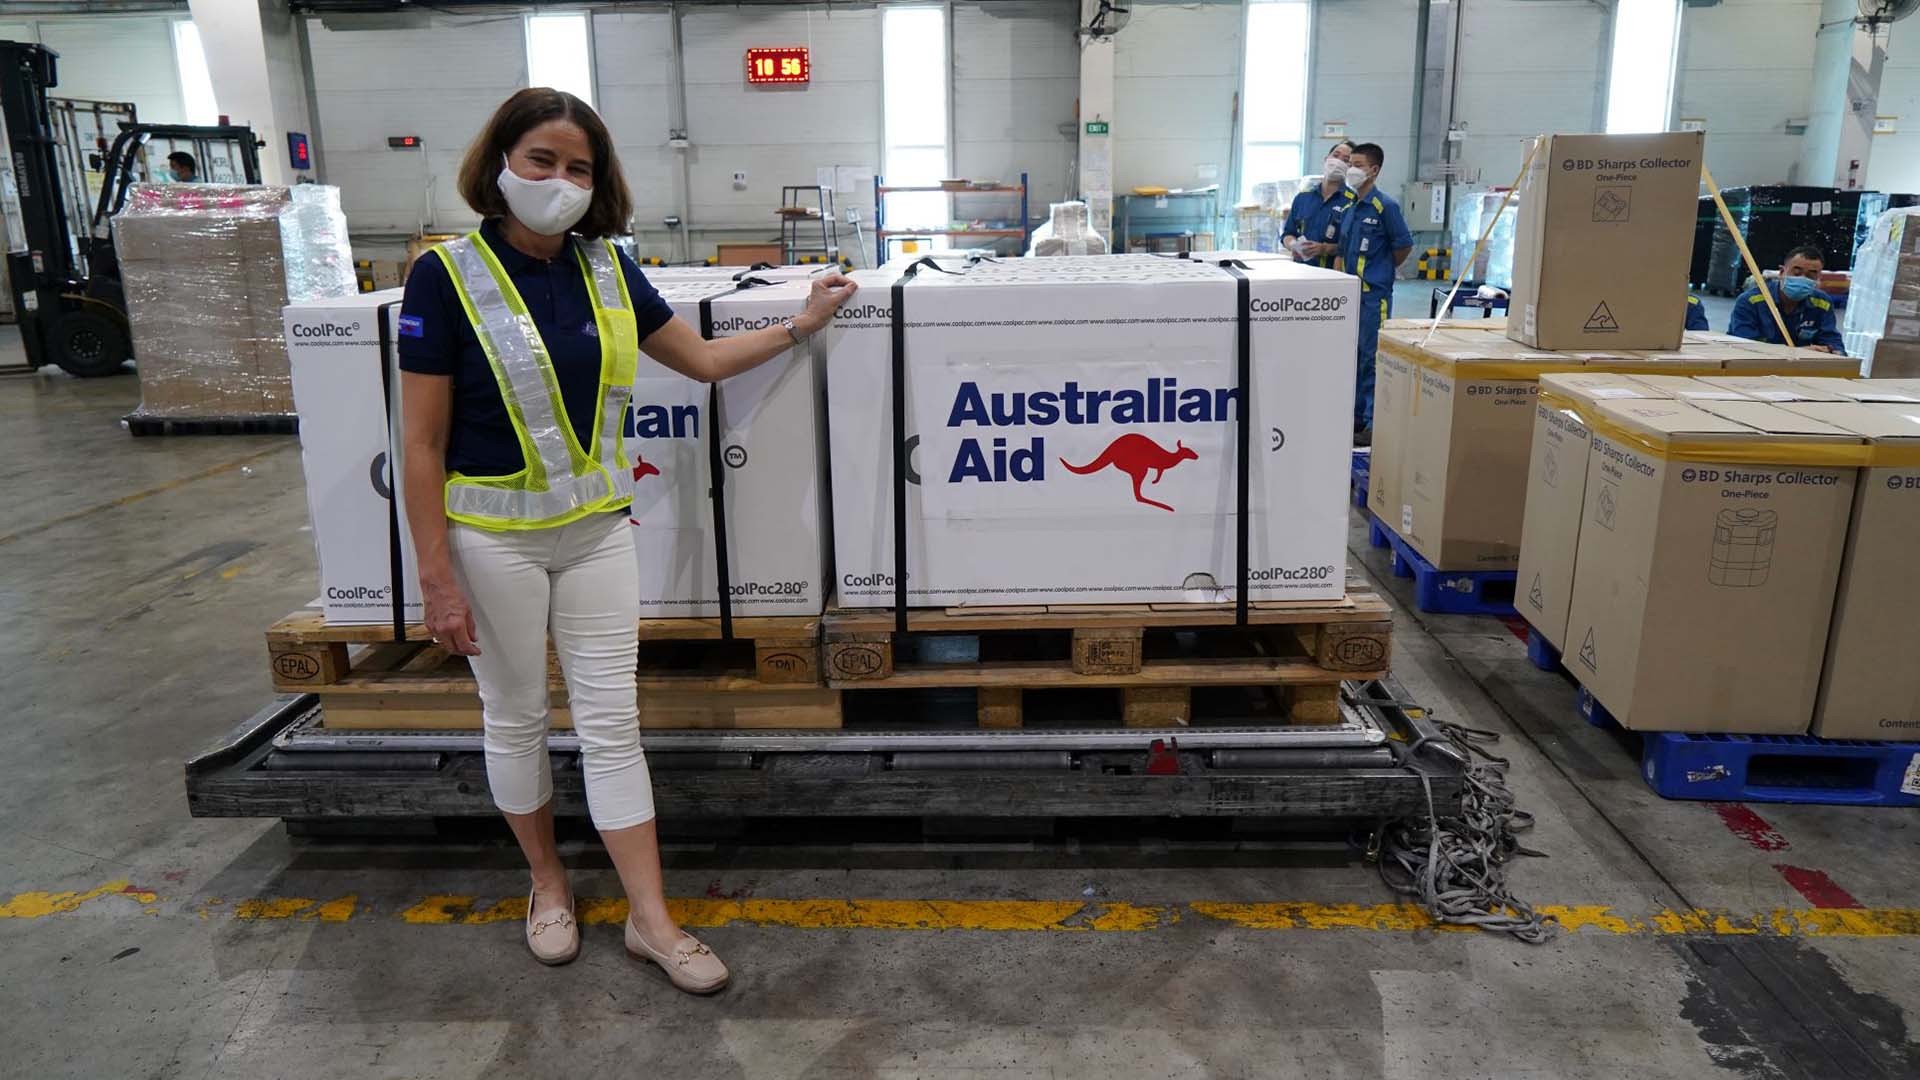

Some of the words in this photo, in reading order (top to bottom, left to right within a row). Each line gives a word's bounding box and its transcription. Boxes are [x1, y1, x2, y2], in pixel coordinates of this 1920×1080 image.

[755, 58, 774, 76] 10
[781, 58, 801, 76] 56
[1576, 159, 1594, 170] BD
[1598, 158, 1637, 171] Sharps
[1640, 158, 1691, 169] Collector
[1596, 174, 1637, 182] One-Piece
[1250, 297, 1341, 312] CoolPac280
[292, 323, 353, 337] CoolPac
[1478, 386, 1492, 395] BD
[1495, 386, 1527, 397] Sharps
[948, 437, 1044, 482] Aid
[1594, 437, 1603, 451] BD
[1603, 443, 1624, 463] Sharps
[1625, 454, 1655, 478] Collector
[1699, 470, 1719, 482] BD
[1724, 471, 1772, 485] Sharps
[1776, 472, 1839, 486] Collector
[1721, 489, 1769, 499] One-Piece
[327, 587, 384, 599] CoolPac
[729, 582, 802, 595] oolPac280
[280, 658, 314, 674] EPAL
[841, 652, 876, 670] EPAL
